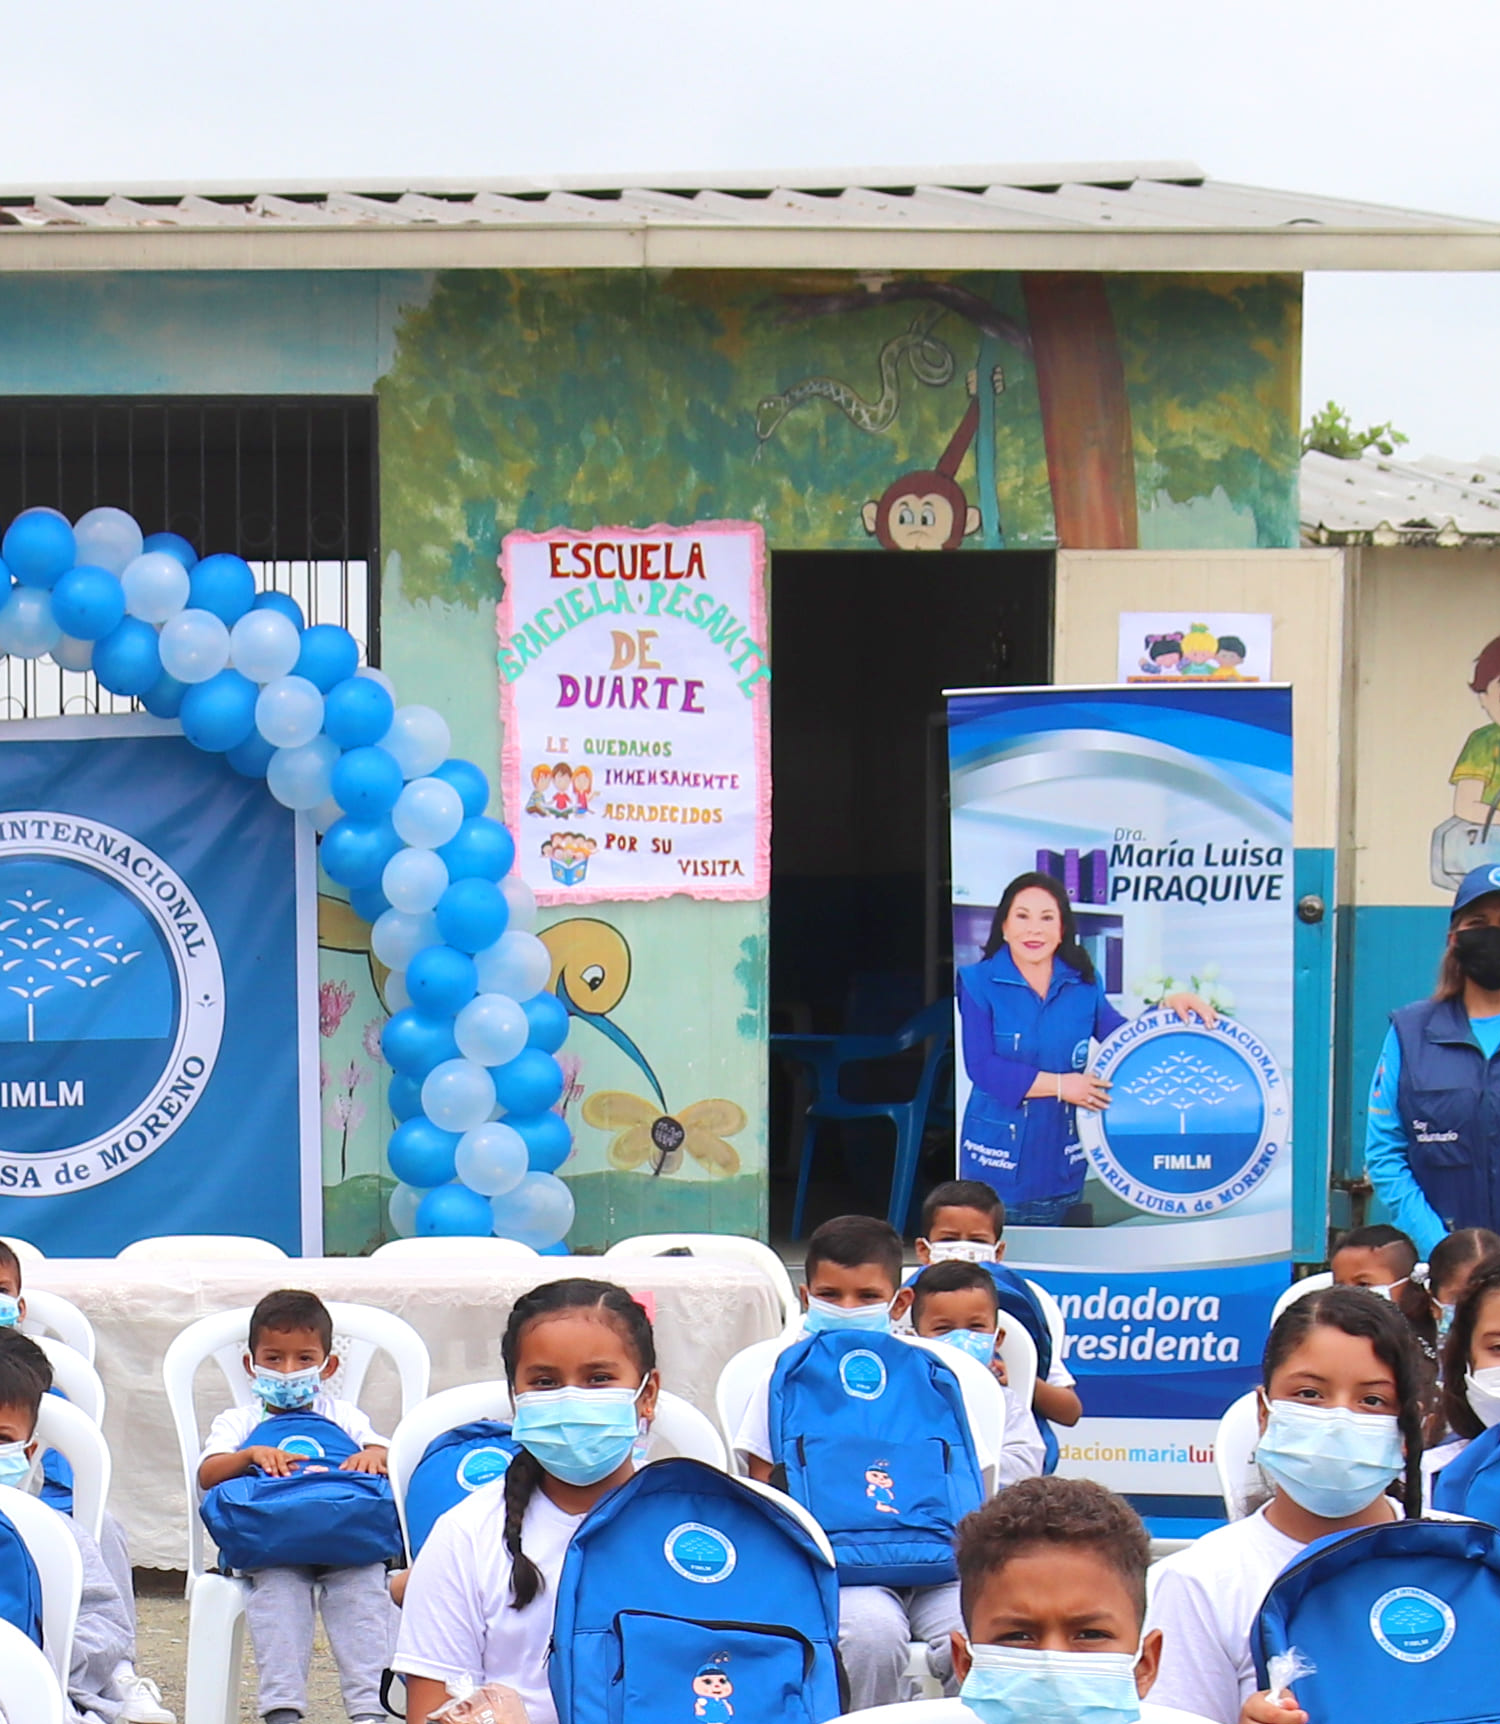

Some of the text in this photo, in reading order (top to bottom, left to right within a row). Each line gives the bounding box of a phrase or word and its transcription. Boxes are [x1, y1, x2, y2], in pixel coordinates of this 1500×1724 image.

[549, 542, 706, 580] ESCUELA
[497, 580, 771, 698] GRACIELA PESANTE
[610, 630, 661, 671] DE
[557, 674, 705, 713] DUARTE
[545, 736, 672, 758] LE QUEDAMOS
[602, 803, 723, 824] AGRADECIDOS
[605, 833, 672, 855] POR SU
[1114, 827, 1147, 842] Dra.
[677, 859, 745, 877] VISITA
[1109, 839, 1284, 868] María Luisa
[1110, 874, 1284, 905] PIRAQUIVE
[1093, 1017, 1158, 1078] NDACIÓN
[54, 1162, 91, 1188] de
[98, 1055, 207, 1173] MORENO
[1090, 1146, 1130, 1197] MARIA
[1135, 1191, 1188, 1213] LUISA
[1194, 1200, 1213, 1213] de
[1217, 1141, 1278, 1203] MORENO
[1153, 1154, 1212, 1170] FIMLM
[1052, 1286, 1220, 1322] ndadora
[1061, 1324, 1240, 1362] residenta
[1059, 1442, 1216, 1464] dacionmarialui
